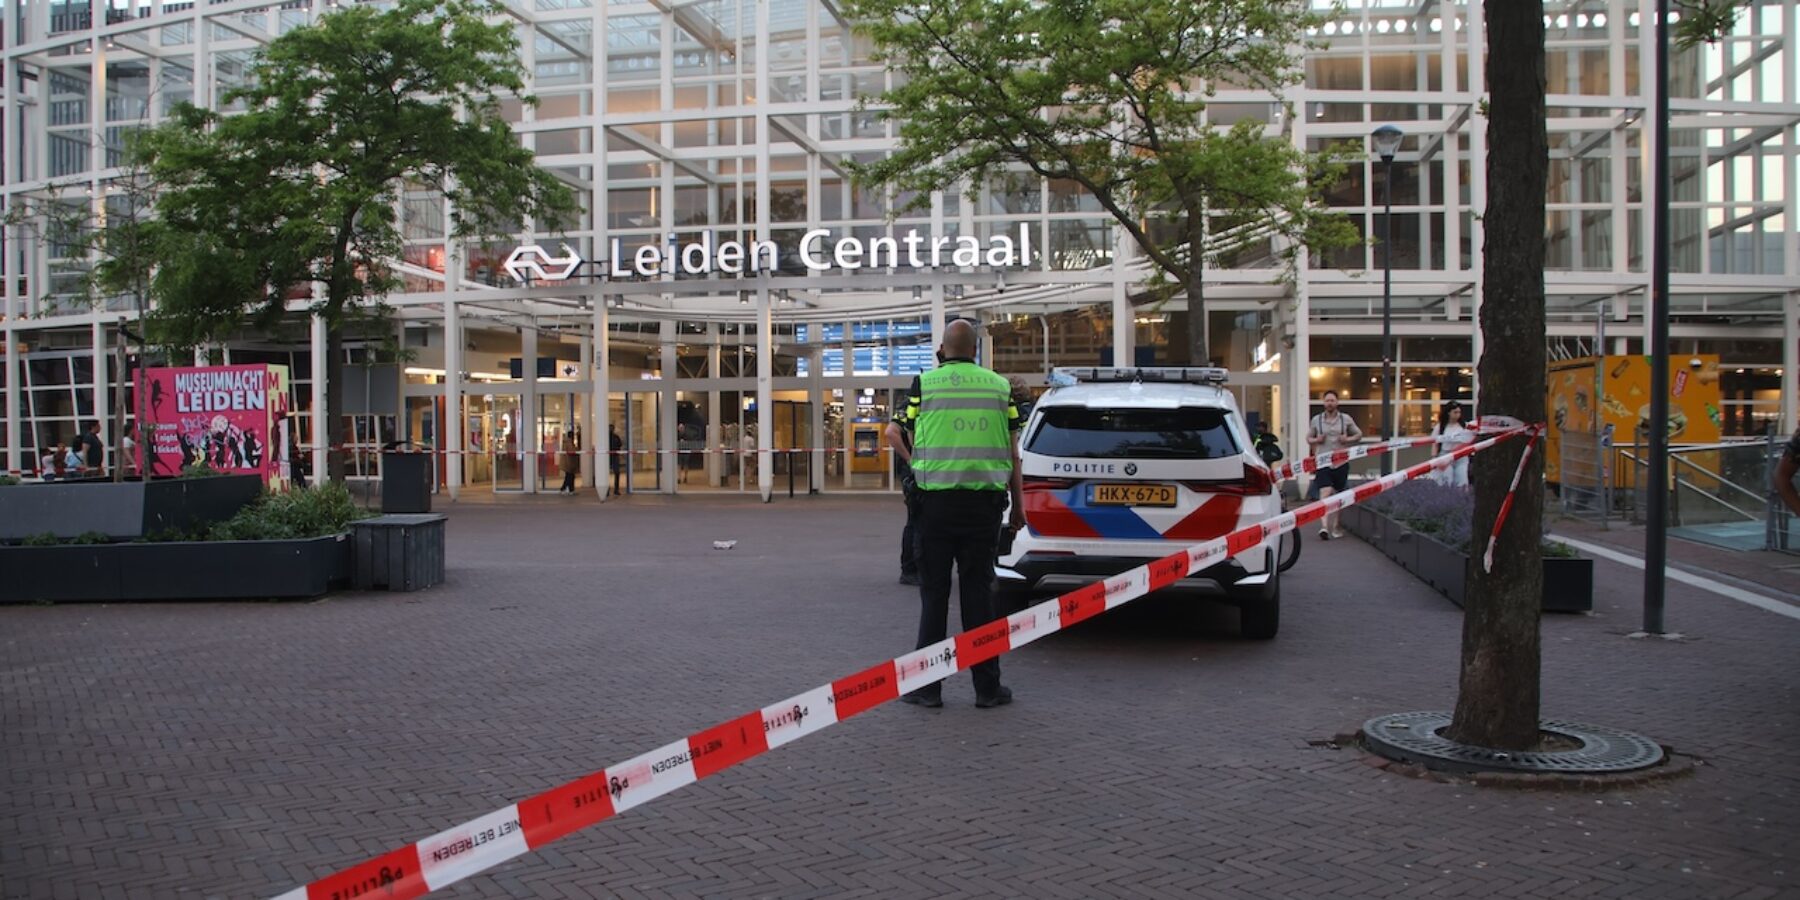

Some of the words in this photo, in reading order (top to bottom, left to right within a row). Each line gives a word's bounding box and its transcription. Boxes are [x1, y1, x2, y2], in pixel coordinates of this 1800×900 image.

[612, 229, 779, 277] Leiden
[799, 222, 1031, 270] Centraal
[176, 370, 264, 393] MUSEUMNACHT
[177, 390, 265, 412] LEIDEN
[953, 417, 988, 431] OvD
[1053, 463, 1115, 473] POLITIE
[1099, 487, 1170, 501] HKX-67-D
[763, 703, 808, 731] POLITIE
[652, 747, 700, 775] BETREDEN
[573, 776, 629, 808] POLITIE
[498, 819, 522, 838] NIET
[432, 829, 495, 863] BETREDEN
